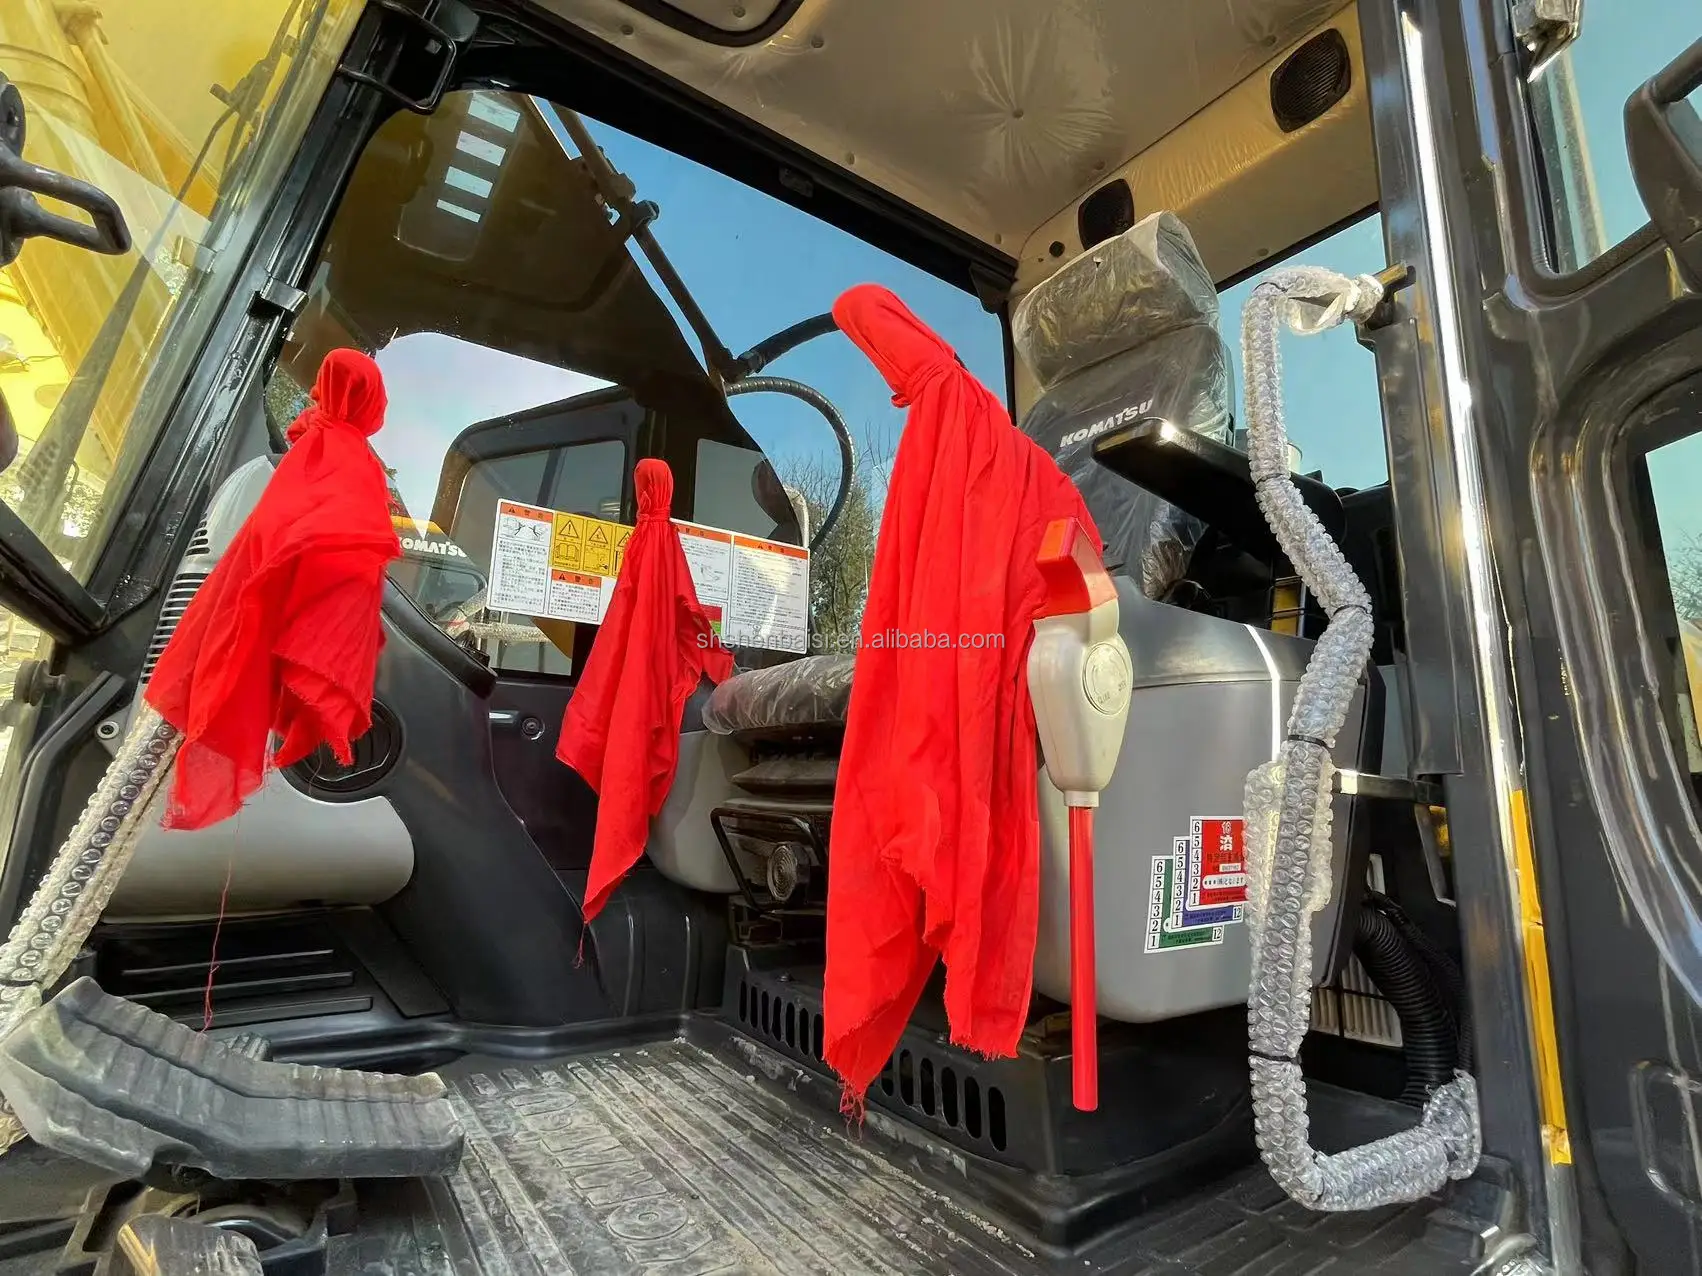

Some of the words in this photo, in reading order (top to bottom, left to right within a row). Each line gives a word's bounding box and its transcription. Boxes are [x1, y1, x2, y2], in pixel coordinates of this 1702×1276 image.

[1059, 399, 1154, 448] KOMATSU
[1233, 907, 1241, 918] 12
[1213, 928, 1222, 940] 12
